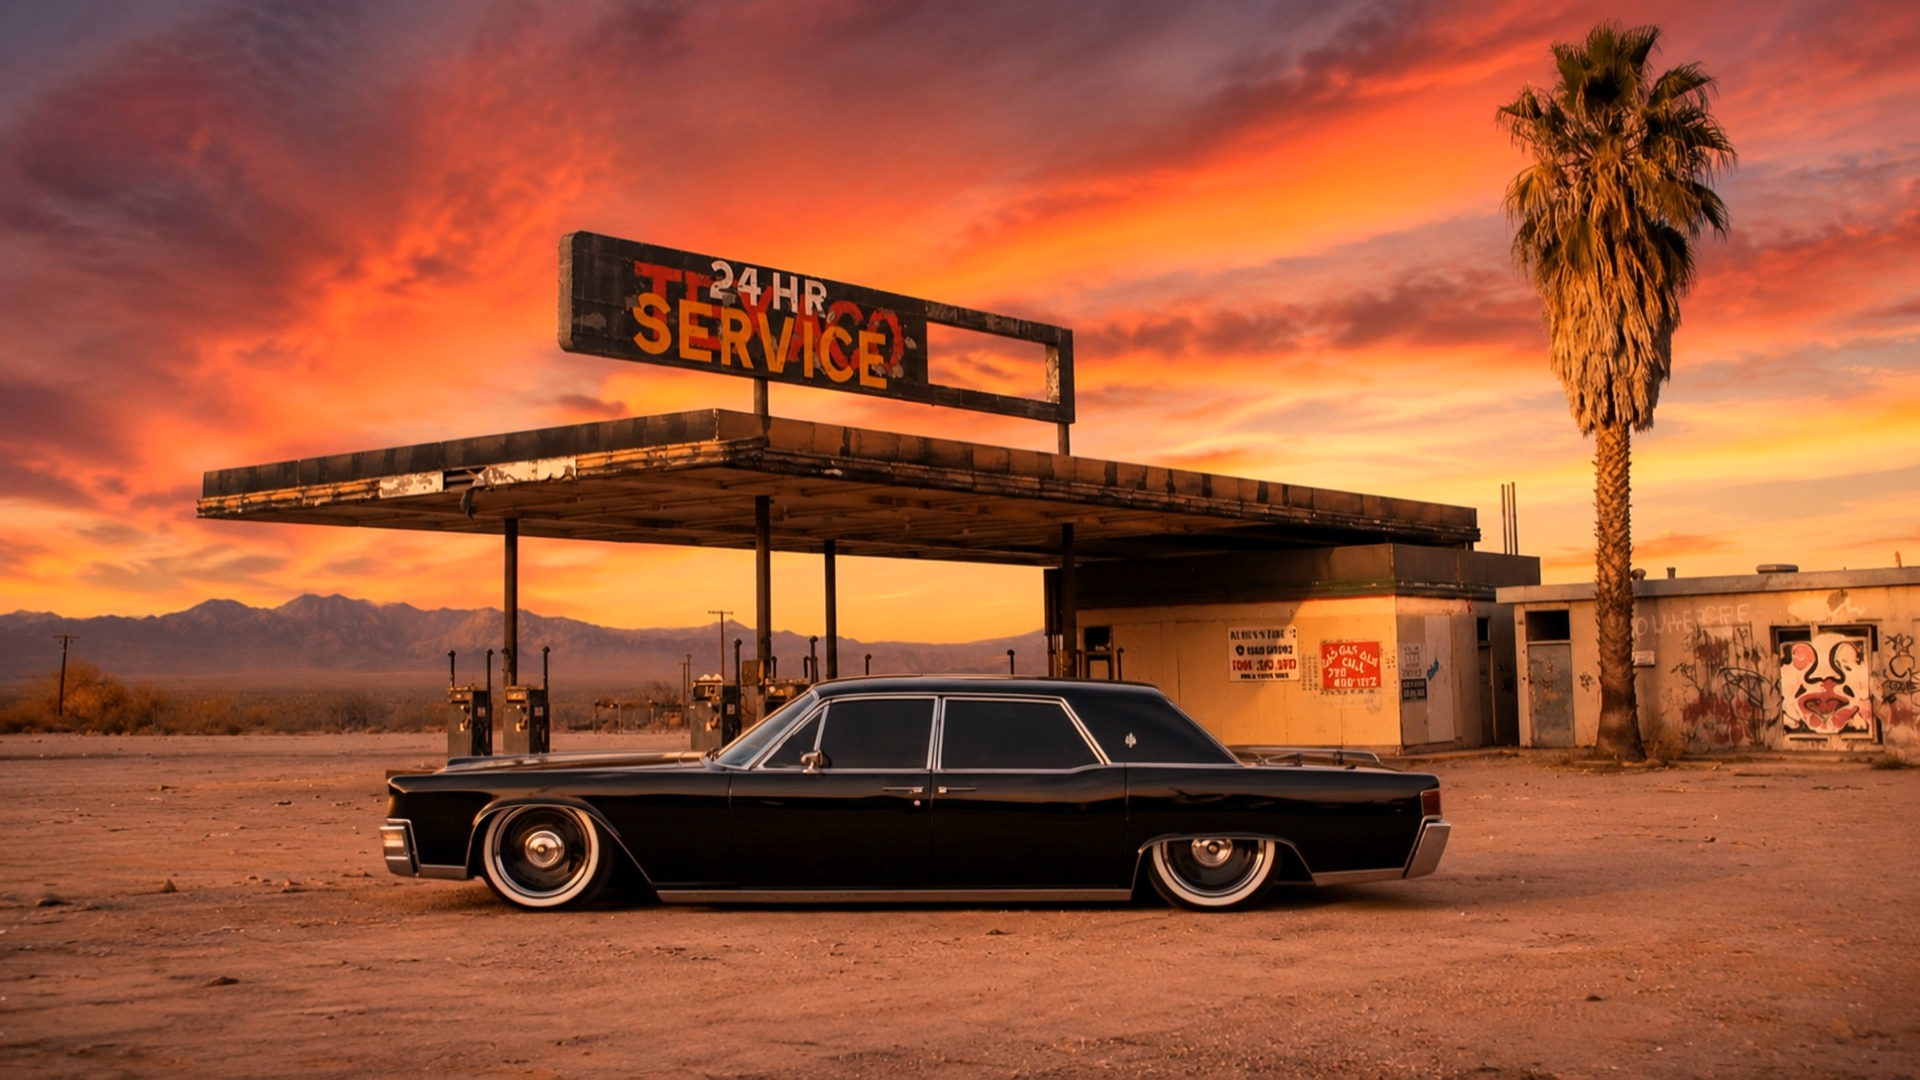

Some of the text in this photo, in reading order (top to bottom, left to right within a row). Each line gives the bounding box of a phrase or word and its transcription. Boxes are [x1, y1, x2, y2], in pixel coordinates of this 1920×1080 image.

[709, 260, 827, 319] 24 HR
[632, 292, 888, 389] SERVICE
